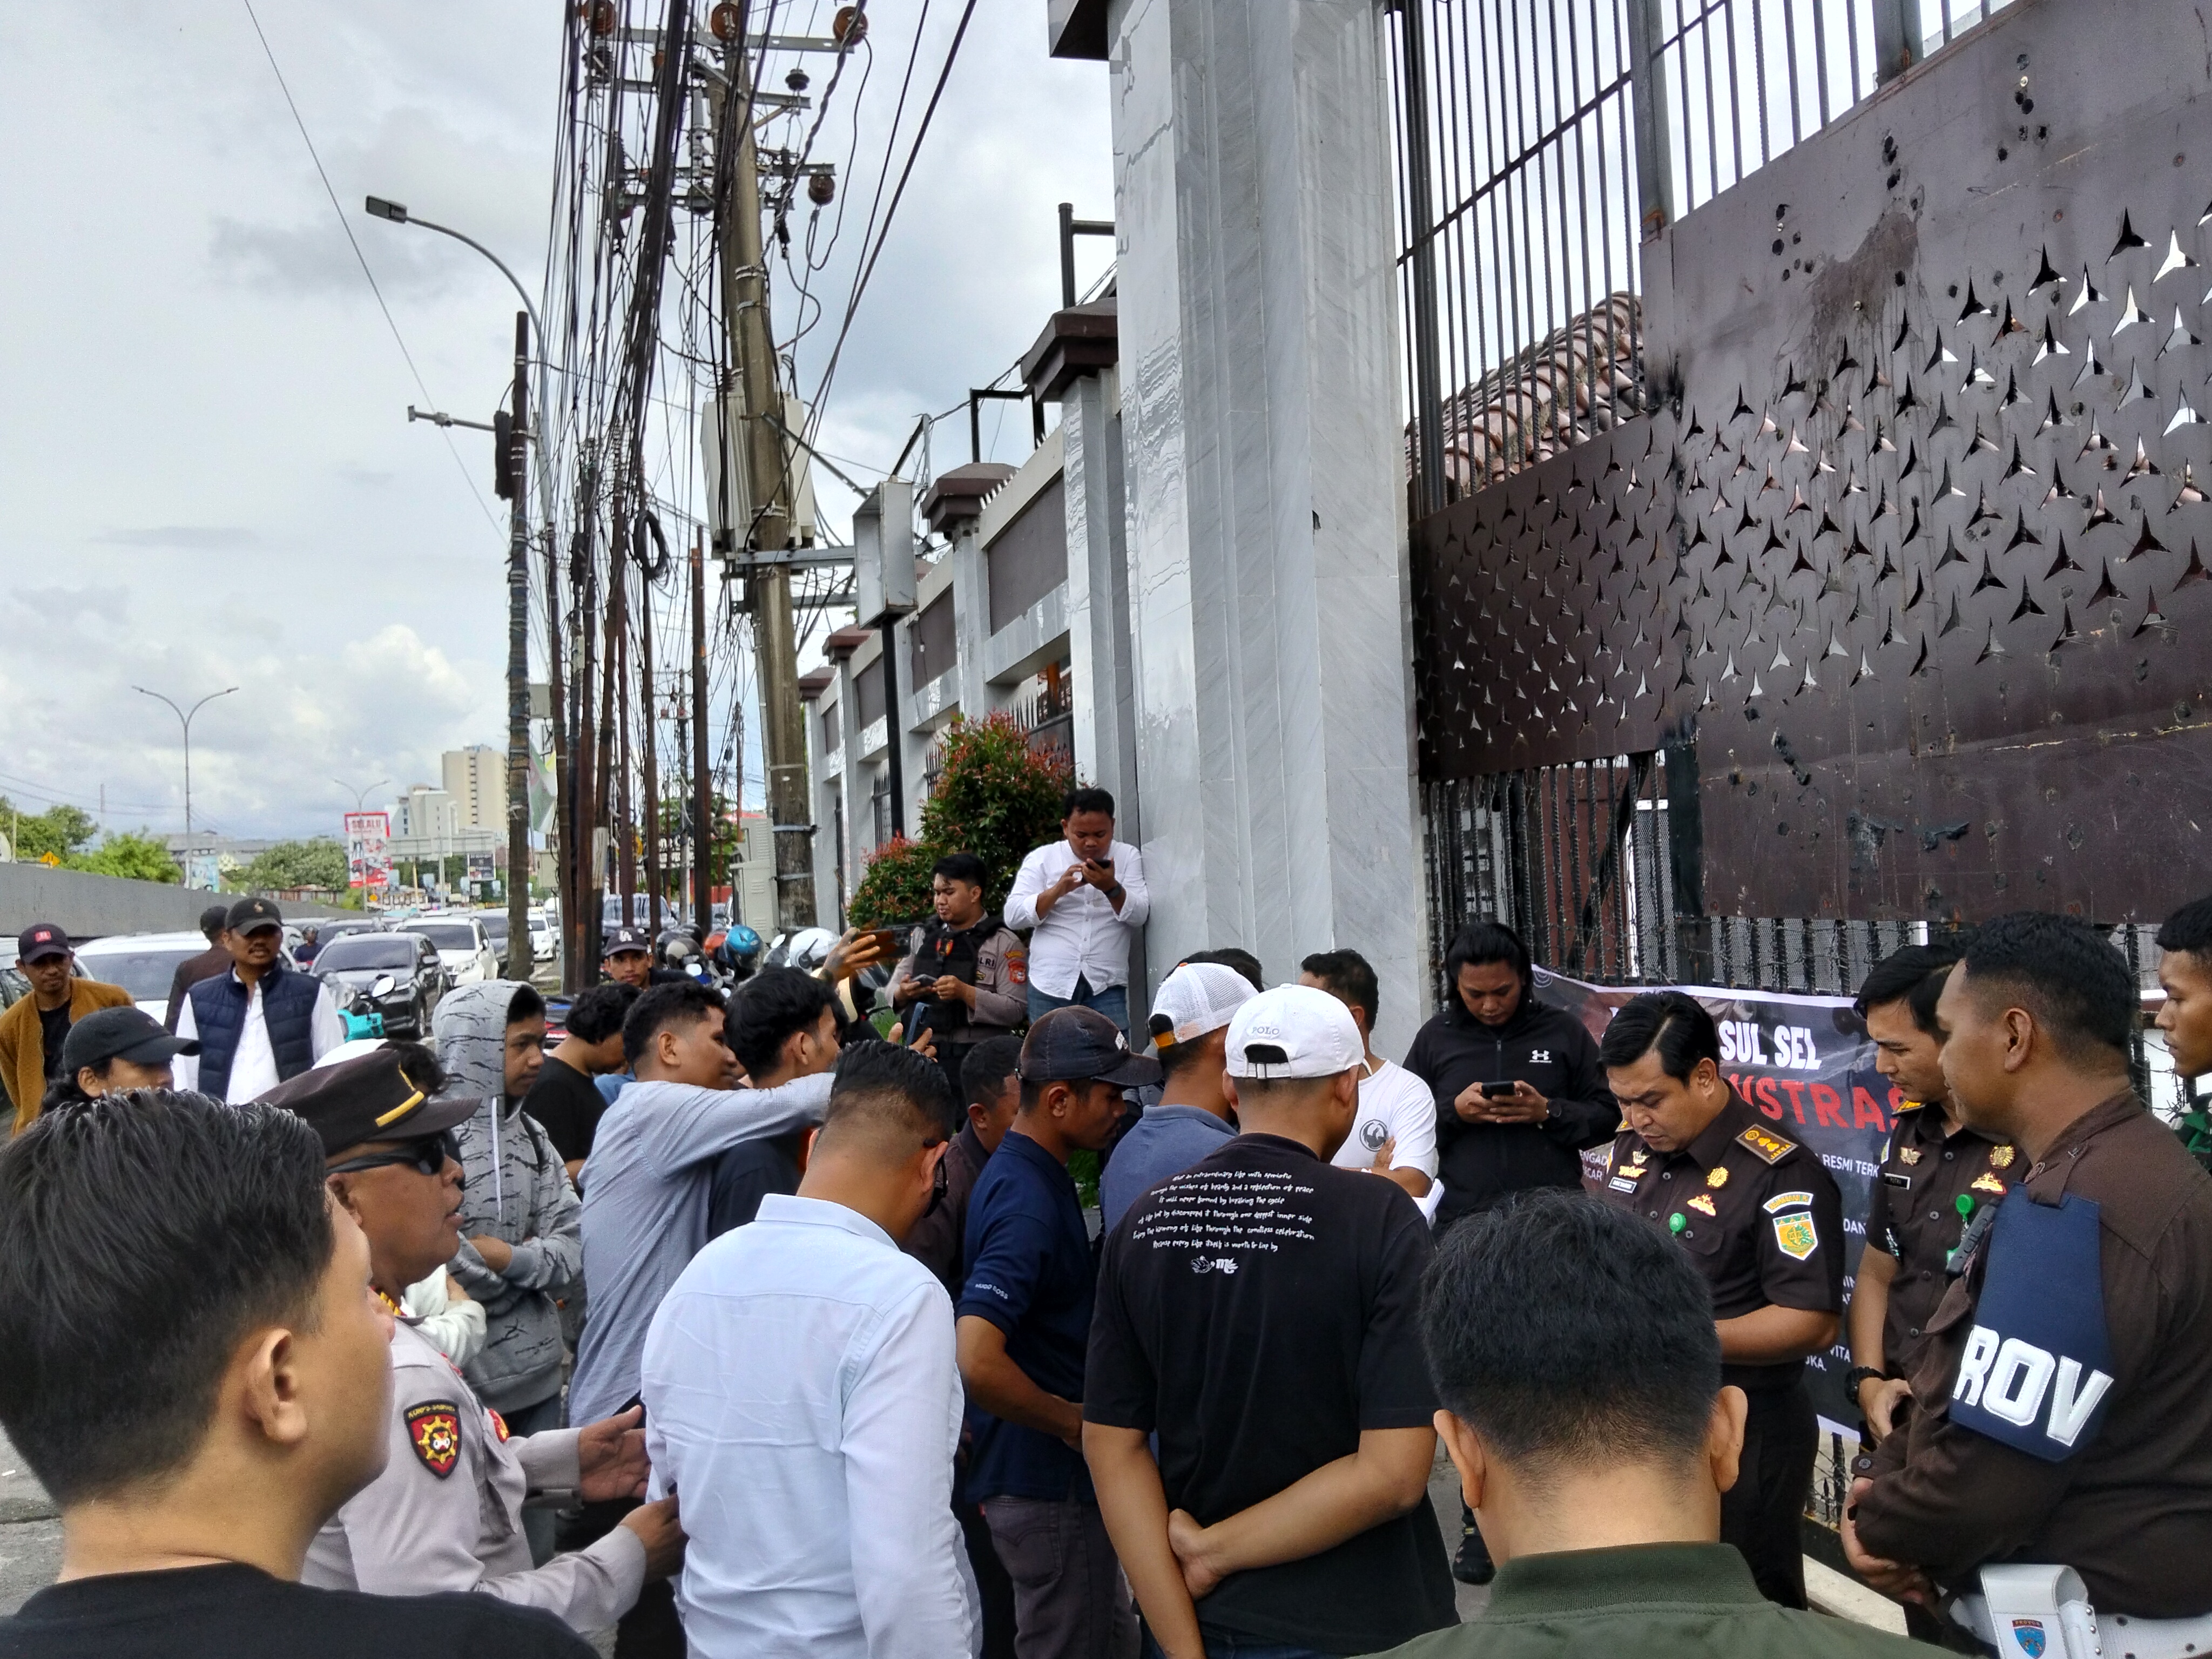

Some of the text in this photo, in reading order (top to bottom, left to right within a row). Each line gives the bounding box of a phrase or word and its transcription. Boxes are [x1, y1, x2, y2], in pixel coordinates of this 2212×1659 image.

[1251, 1026, 1279, 1035] POLO
[1718, 1020, 1822, 1070] SUL SEL
[1822, 1154, 1880, 1178] RESMI TERK
[1219, 1196, 1227, 1205] by
[1277, 1212, 1296, 1220] inner
[1298, 1215, 1312, 1224] side
[1205, 1224, 1231, 1235] through
[1233, 1225, 1243, 1234] the
[1231, 1240, 1250, 1249] worth
[1271, 1242, 1278, 1252] by
[1952, 1325, 2114, 1447] ROV
